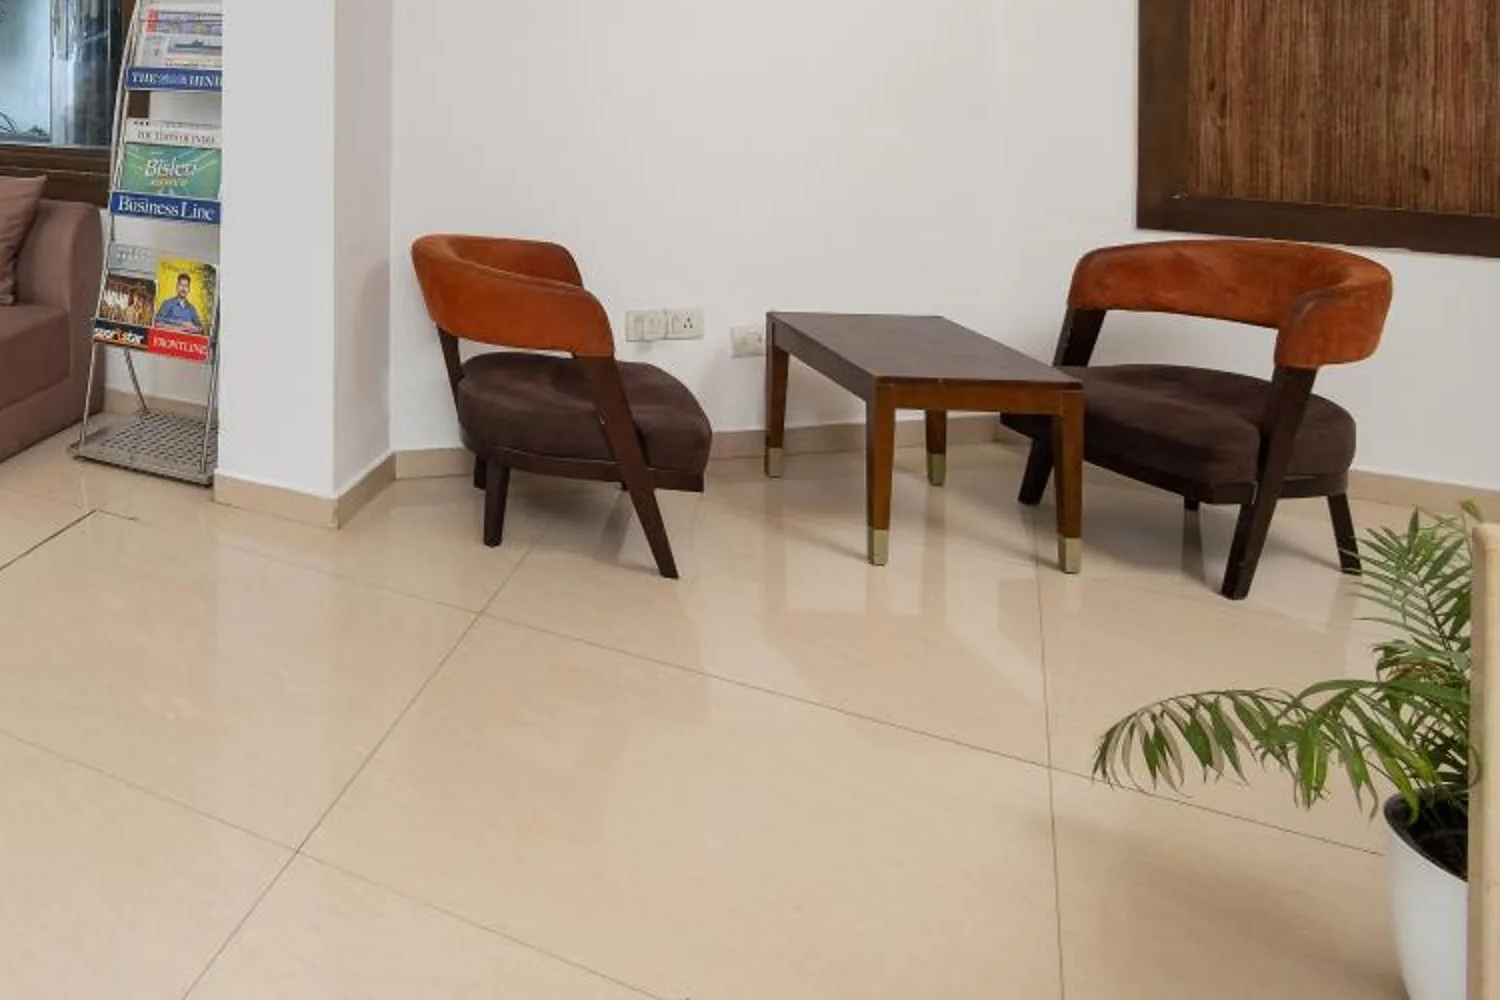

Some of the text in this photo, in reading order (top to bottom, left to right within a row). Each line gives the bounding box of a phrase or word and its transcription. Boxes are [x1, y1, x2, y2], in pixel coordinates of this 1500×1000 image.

[132, 71, 156, 84] THE
[118, 195, 215, 220] Business Line
